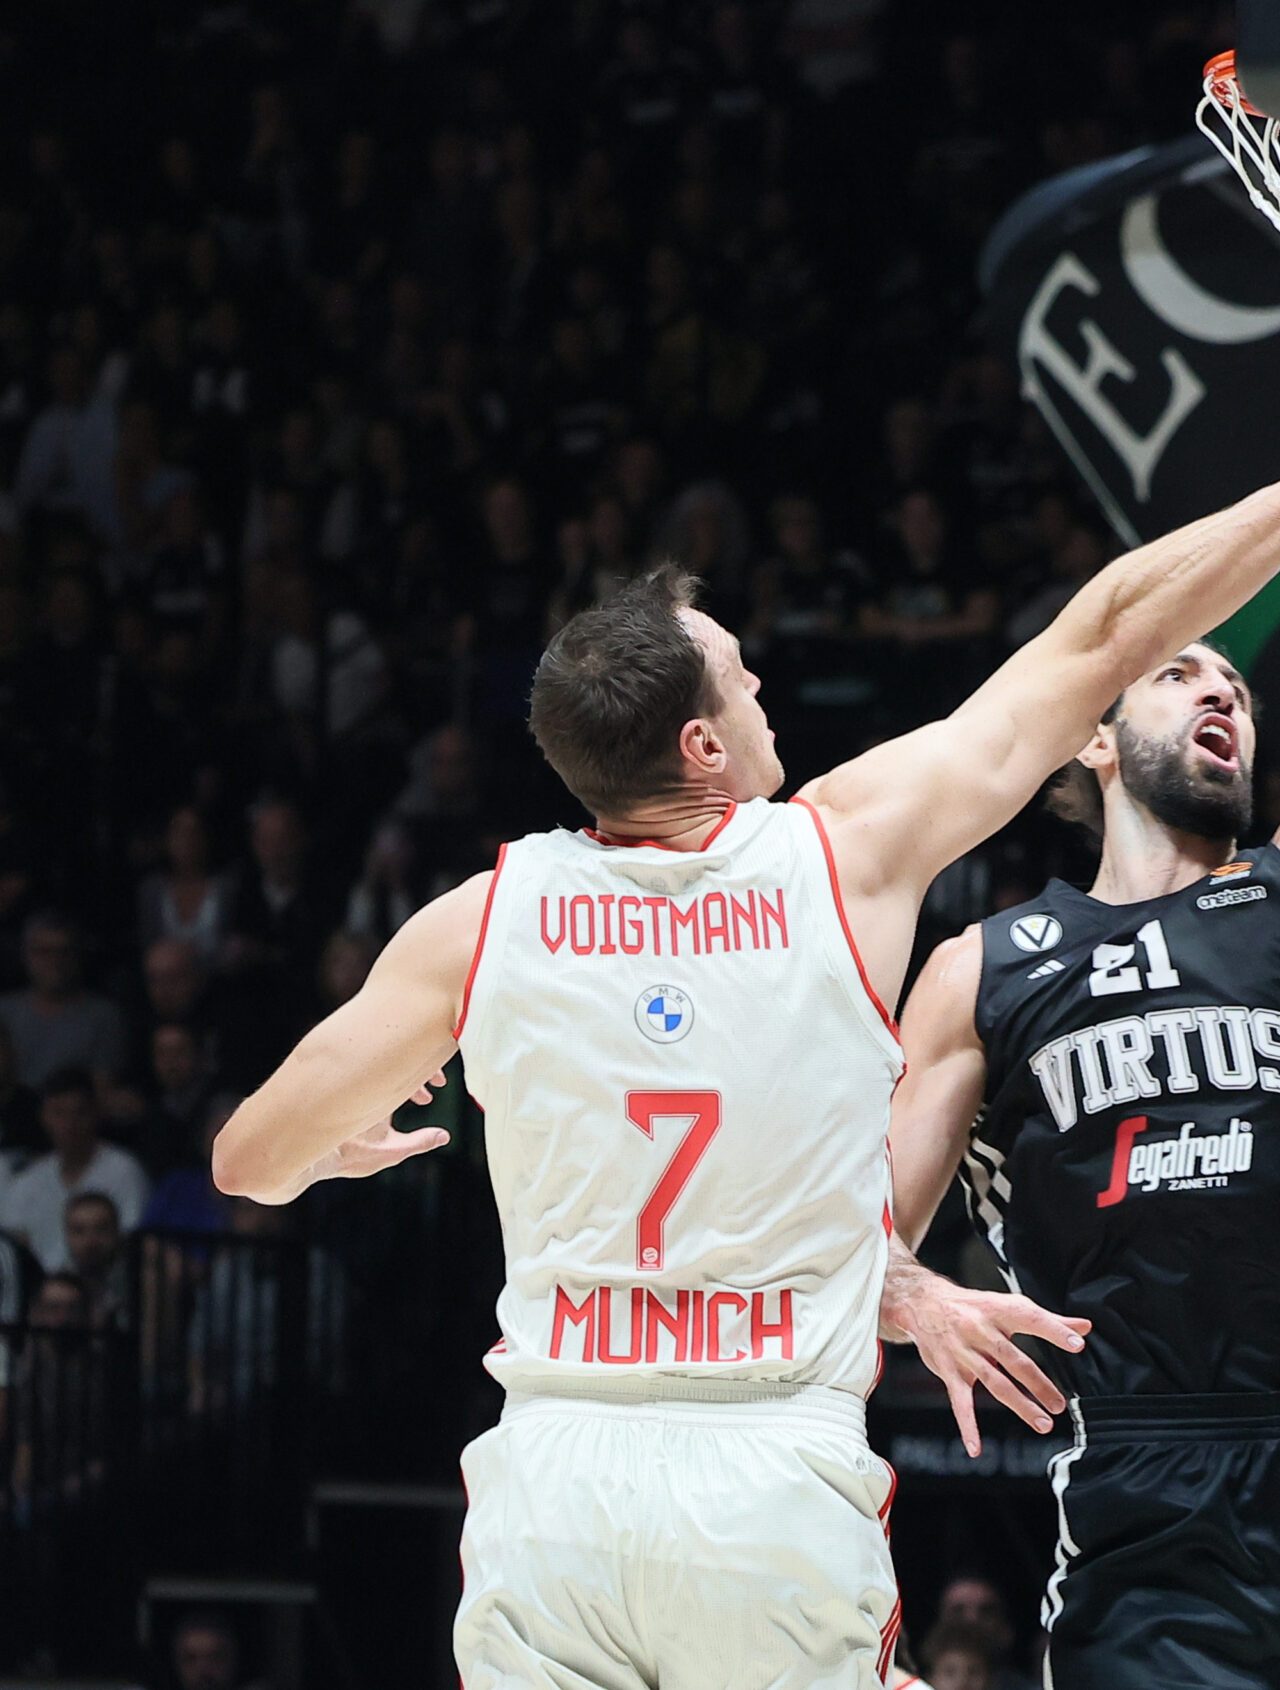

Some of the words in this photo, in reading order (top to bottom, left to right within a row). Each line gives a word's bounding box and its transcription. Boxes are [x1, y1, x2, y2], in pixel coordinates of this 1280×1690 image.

[540, 888, 790, 956] VOIGTMANN
[1196, 885, 1268, 910] oneteam
[642, 987, 686, 1003] BMW
[1088, 919, 1181, 998] 21
[625, 1089, 723, 1271] 7
[1096, 1115, 1254, 1209] Segafredo
[1168, 1176, 1228, 1191] ZANETTI
[548, 1285, 795, 1365] MUNICH
